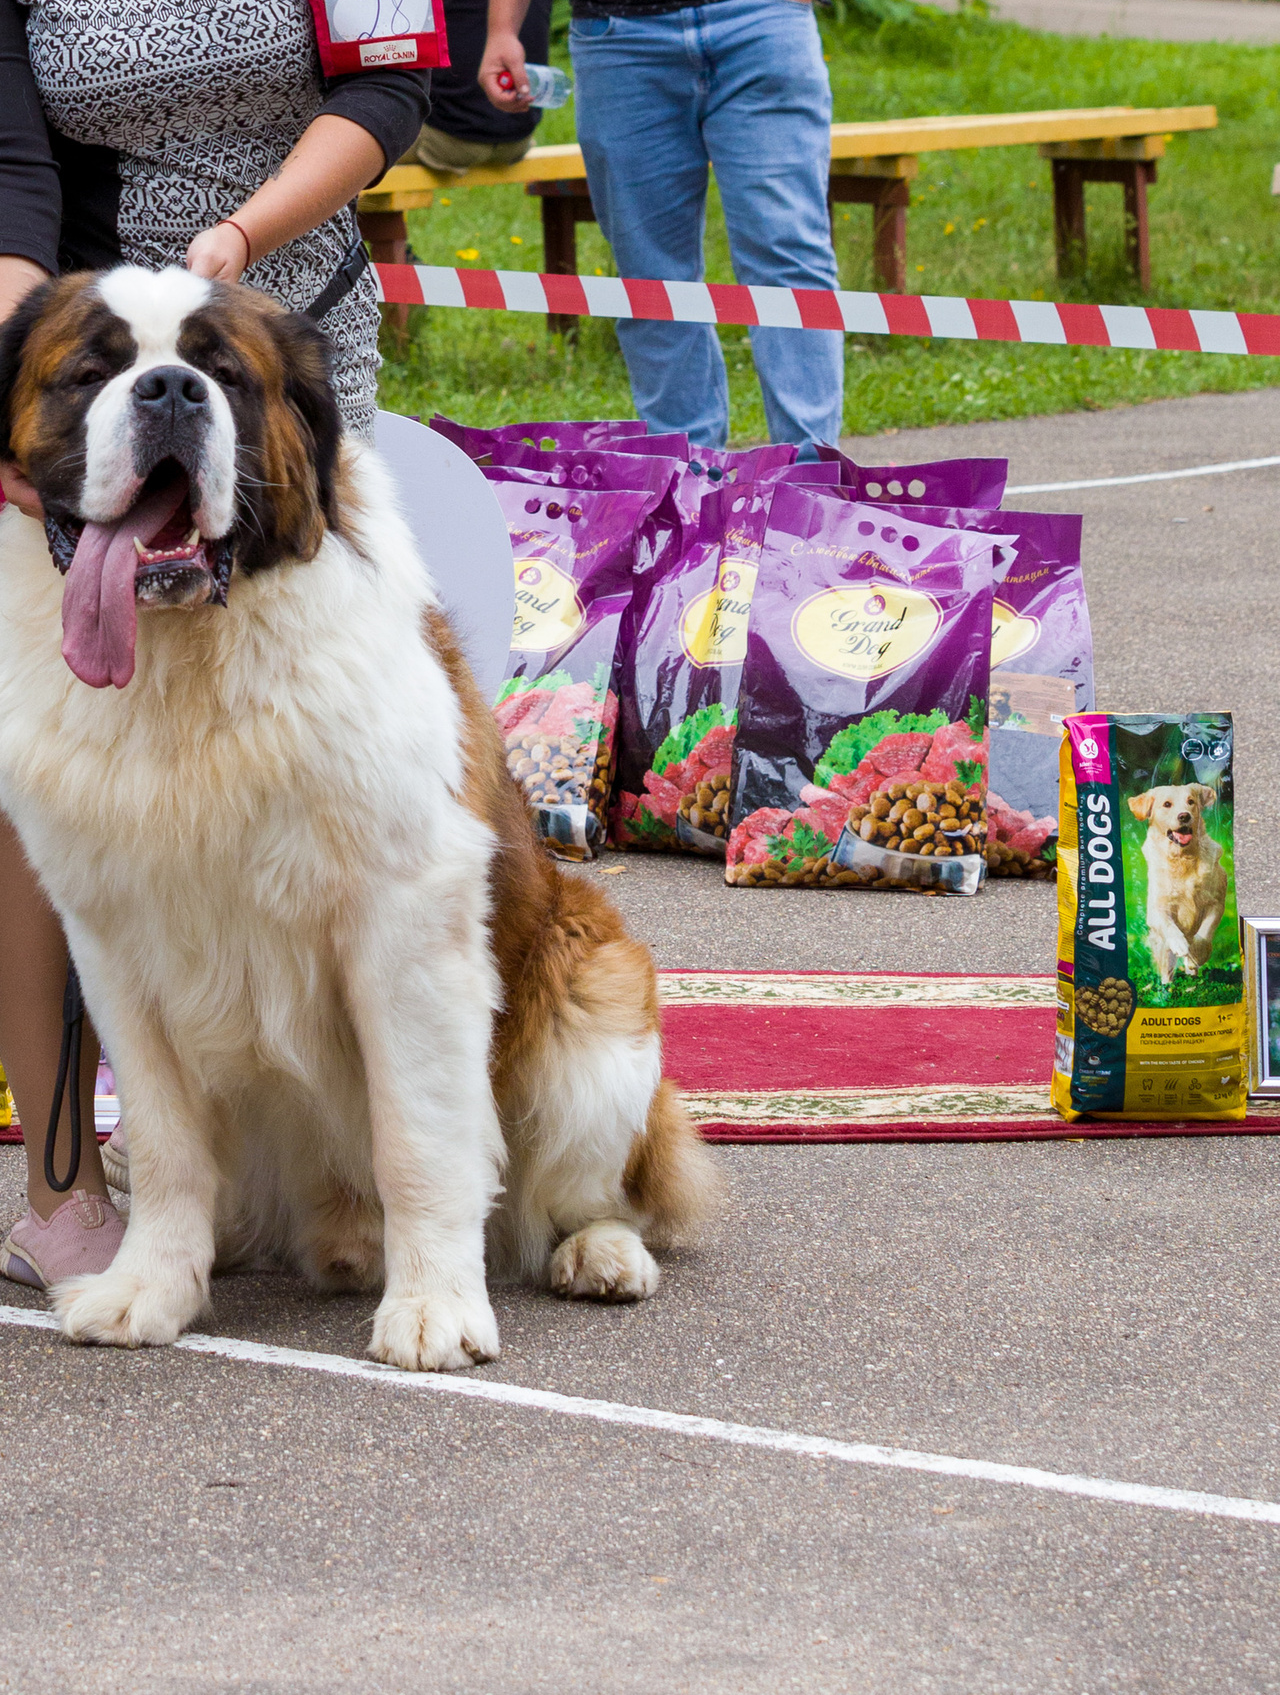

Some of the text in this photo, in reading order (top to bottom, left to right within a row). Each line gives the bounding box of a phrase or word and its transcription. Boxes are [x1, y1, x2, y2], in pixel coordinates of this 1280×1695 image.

[364, 51, 415, 63] ROYAL CANIN
[1002, 567, 1050, 583] итомцам
[514, 590, 560, 614] and
[513, 603, 536, 636] og
[830, 606, 907, 633] Grand
[839, 633, 892, 662] Dog
[1087, 793, 1115, 884] DOGS
[1076, 893, 1087, 936] Complete
[1087, 891, 1116, 951] ALL
[1140, 1016, 1202, 1027] ADULT DOGS
[1153, 1031, 1185, 1039] ВЗРОСЛЫХ
[1217, 1028, 1233, 1036] ПОРОД
